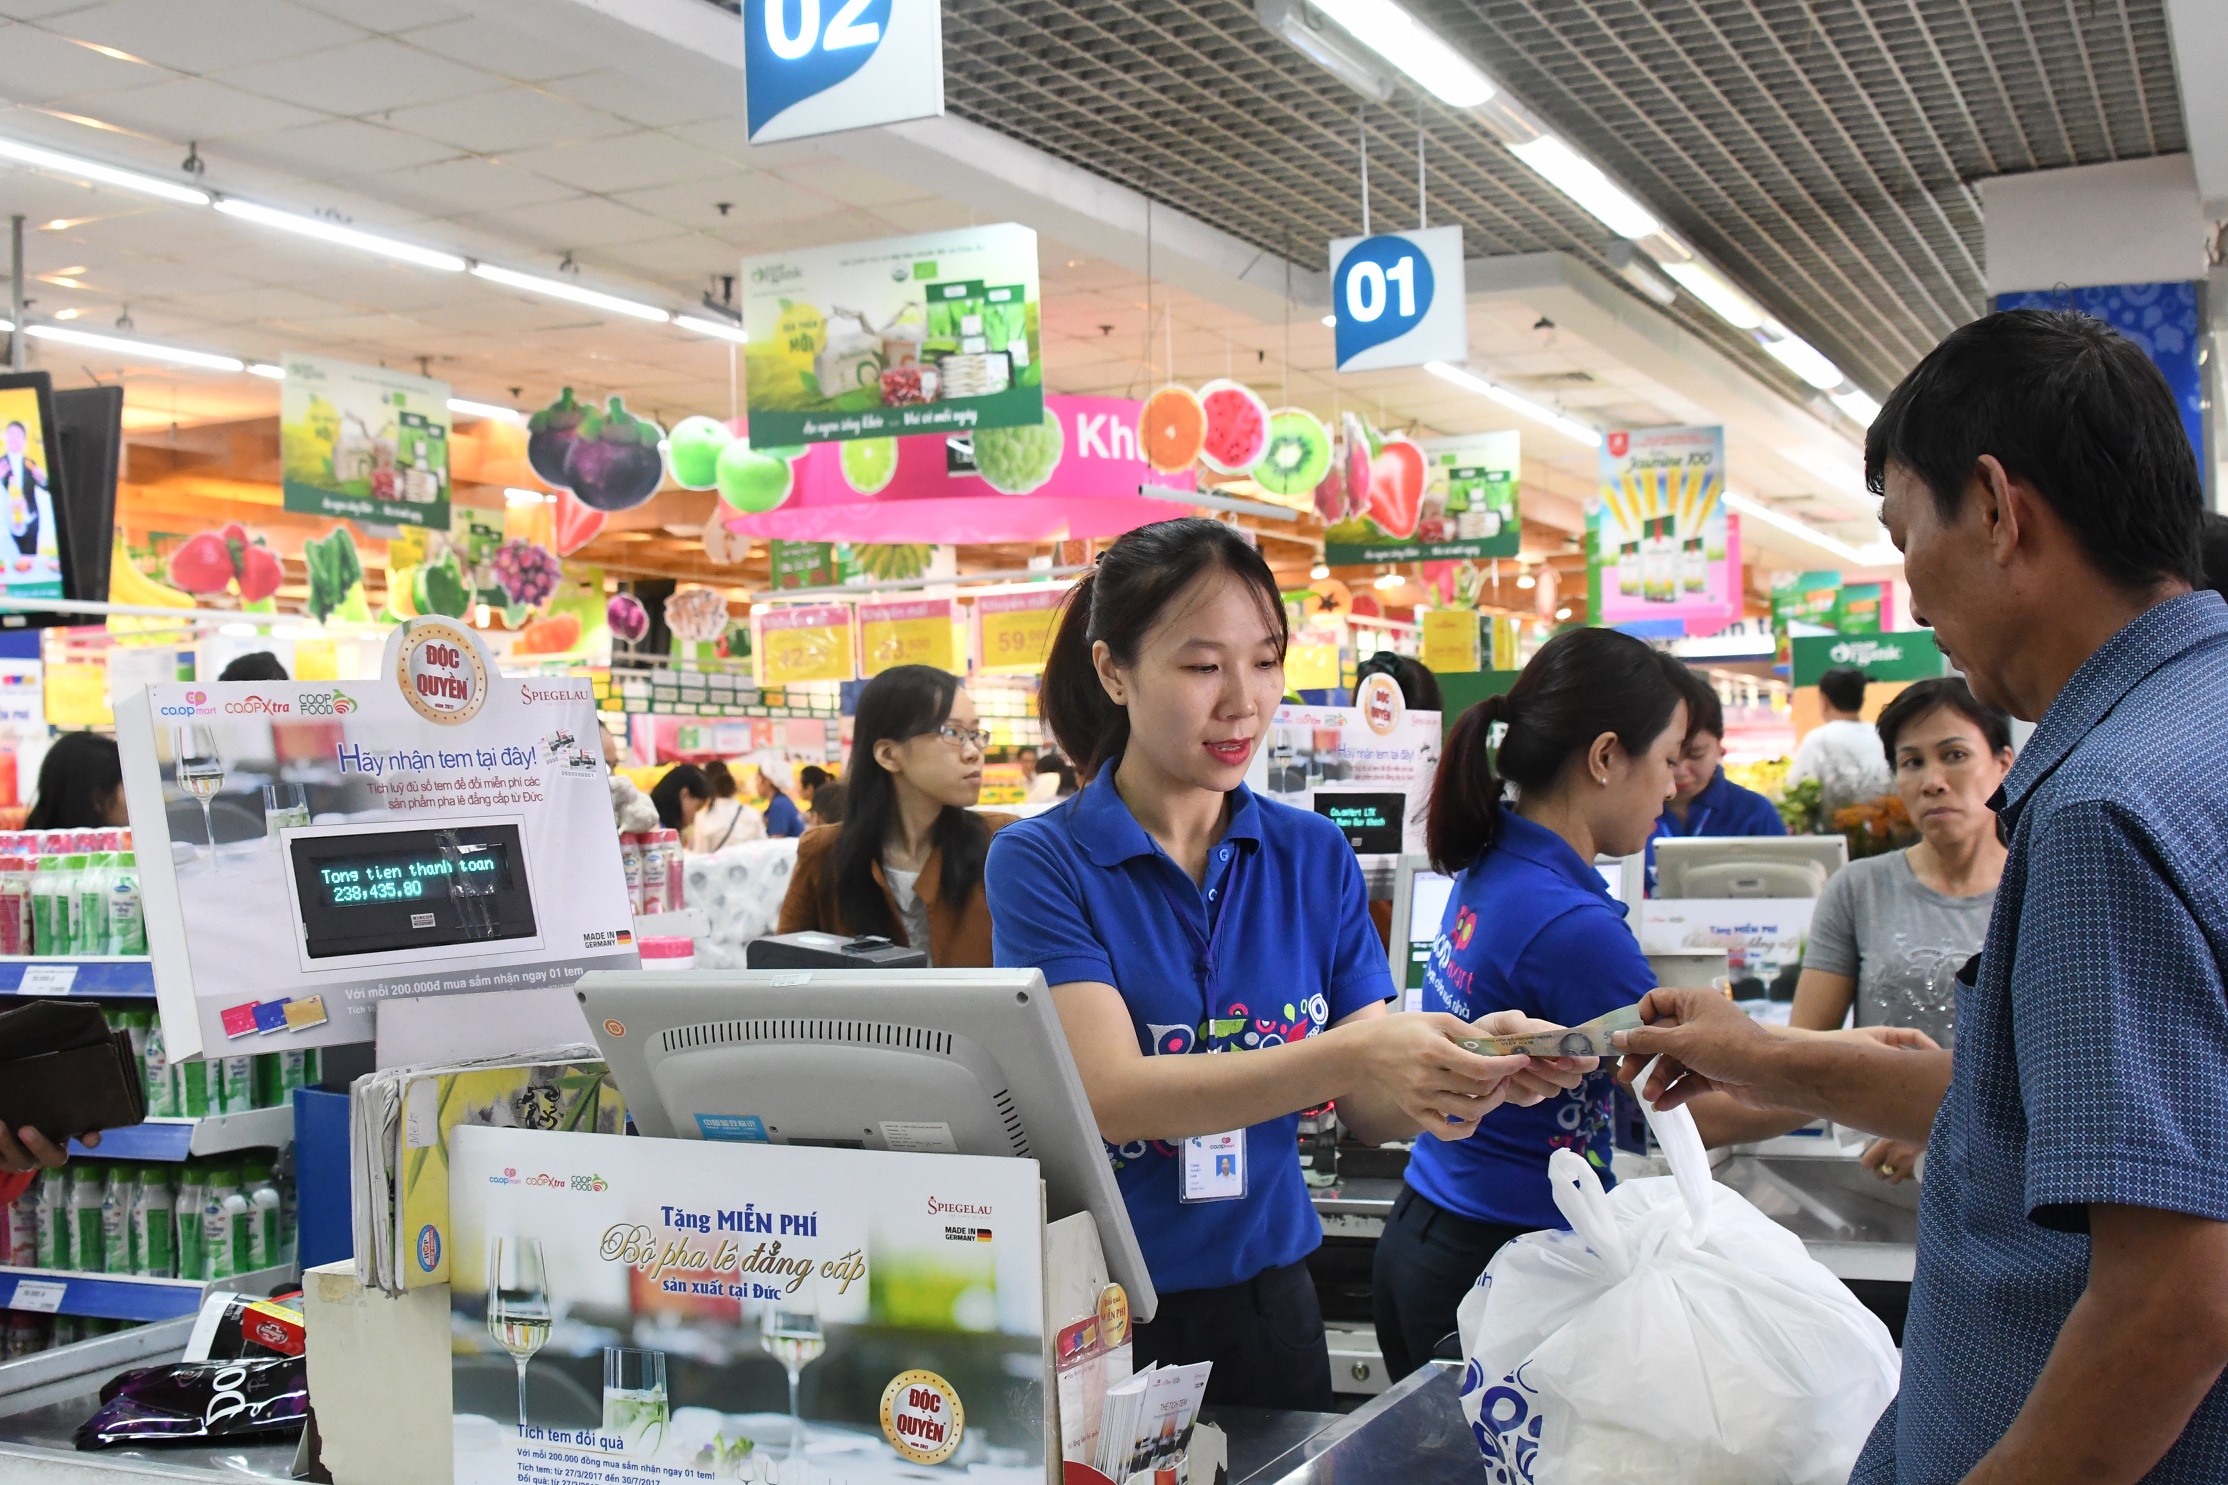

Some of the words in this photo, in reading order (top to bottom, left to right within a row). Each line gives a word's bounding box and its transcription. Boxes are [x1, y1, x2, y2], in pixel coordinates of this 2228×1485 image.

[765, 0, 879, 60] 02
[1346, 256, 1415, 322] 01
[1077, 413, 1147, 463] Kh
[426, 644, 459, 670] ĐỘC
[417, 672, 468, 700] QUYỀN
[300, 705, 334, 715] FOOD
[338, 744, 384, 776] Hãy
[389, 750, 434, 773] nhận
[438, 750, 473, 769] tem
[476, 748, 497, 770] tại
[501, 746, 537, 770] đây!
[367, 783, 388, 794] Tích
[407, 781, 418, 793] đủ
[421, 779, 432, 791] số
[434, 780, 452, 791] tem
[454, 777, 466, 790] để
[469, 777, 482, 790] đổi
[484, 776, 506, 788] miễn
[508, 777, 522, 789] phí
[524, 776, 540, 787] các
[388, 797, 406, 809] sản
[409, 795, 435, 810] phẩm
[438, 796, 455, 808] pha
[457, 795, 466, 805] lê
[493, 791, 509, 805] cấp
[511, 792, 521, 802] từ
[523, 791, 543, 801] Đức
[321, 868, 359, 885] Tong
[366, 865, 402, 880] tien
[408, 859, 453, 877] thanh
[459, 857, 494, 873] toan
[584, 932, 605, 941] MADE
[607, 931, 615, 939] IN
[585, 940, 615, 949] GERMANY
[344, 988, 365, 1000] Với
[368, 985, 388, 999] mỗi
[391, 980, 441, 996] 200.000đ
[443, 980, 466, 990] mua
[469, 974, 491, 988] sắm
[494, 972, 519, 986] nhận
[522, 972, 547, 985] ngay
[549, 968, 561, 978] 01
[564, 967, 583, 977] tem
[610, 1023, 620, 1032] 10
[928, 1195, 992, 1215] SPIEGELAU
[661, 1205, 711, 1234] Tặng
[717, 1203, 773, 1235] MIỄN
[780, 1211, 818, 1237] PHÍ
[945, 1226, 966, 1235] MADE
[945, 1234, 976, 1242] GERMANY
[600, 1223, 657, 1270] Bộ
[651, 1237, 709, 1280] pha
[713, 1240, 738, 1270] lê
[742, 1240, 815, 1294] đẳng
[820, 1248, 865, 1294] cấp
[663, 1277, 687, 1293] sản
[691, 1280, 724, 1296] xuất
[728, 1282, 748, 1300] tại
[753, 1284, 782, 1301] Đức
[909, 1388, 941, 1413] ĐỘC
[516, 1424, 544, 1440] Tích
[548, 1427, 572, 1443] tem
[575, 1428, 596, 1447] đổi
[600, 1436, 624, 1450] quà
[897, 1414, 944, 1443] QUYỀN
[517, 1448, 530, 1458] Với
[532, 1448, 547, 1459] mỗi
[548, 1451, 578, 1464] 200.000
[580, 1455, 601, 1468] đồng
[603, 1460, 620, 1469] mua
[621, 1459, 639, 1471] sắm
[640, 1464, 660, 1475] nhận
[663, 1468, 683, 1479] ngay
[684, 1469, 694, 1478] 01
[696, 1470, 715, 1480] tem!
[517, 1462, 534, 1473] Tích
[536, 1464, 552, 1474] tem:
[554, 1465, 563, 1475] từ
[565, 1468, 602, 1481] 27/3/2017
[604, 1473, 620, 1483] đến
[621, 1475, 660, 1485] 30/7/2017
[517, 1473, 531, 1485] Đổi
